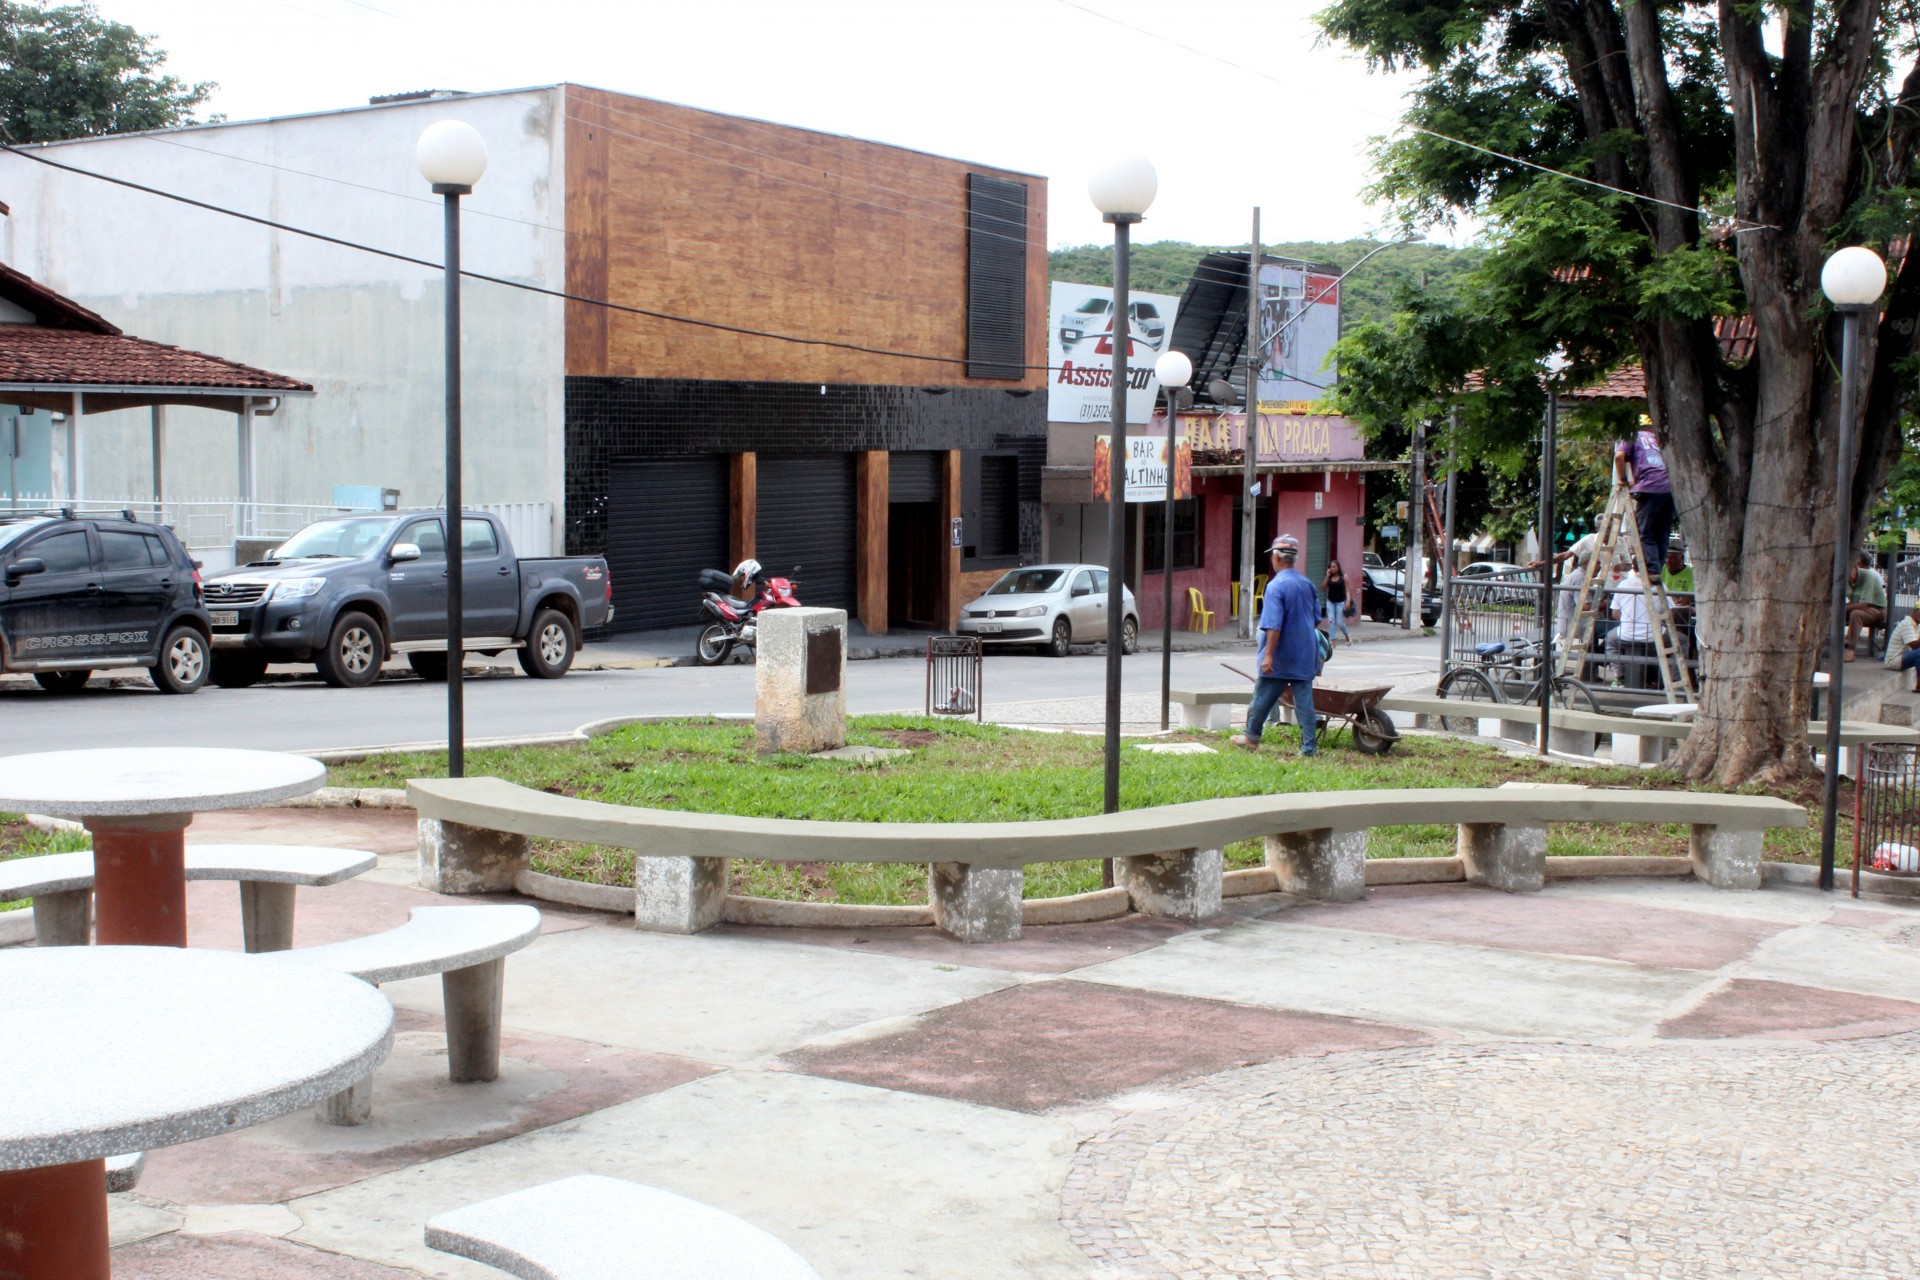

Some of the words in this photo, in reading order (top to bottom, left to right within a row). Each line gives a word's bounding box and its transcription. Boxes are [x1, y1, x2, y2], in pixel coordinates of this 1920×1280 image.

[1258, 420, 1279, 455] NA
[1283, 420, 1331, 457] PRAÇA
[1133, 441, 1154, 458] BAR
[25, 631, 148, 649] CROSSFOX
